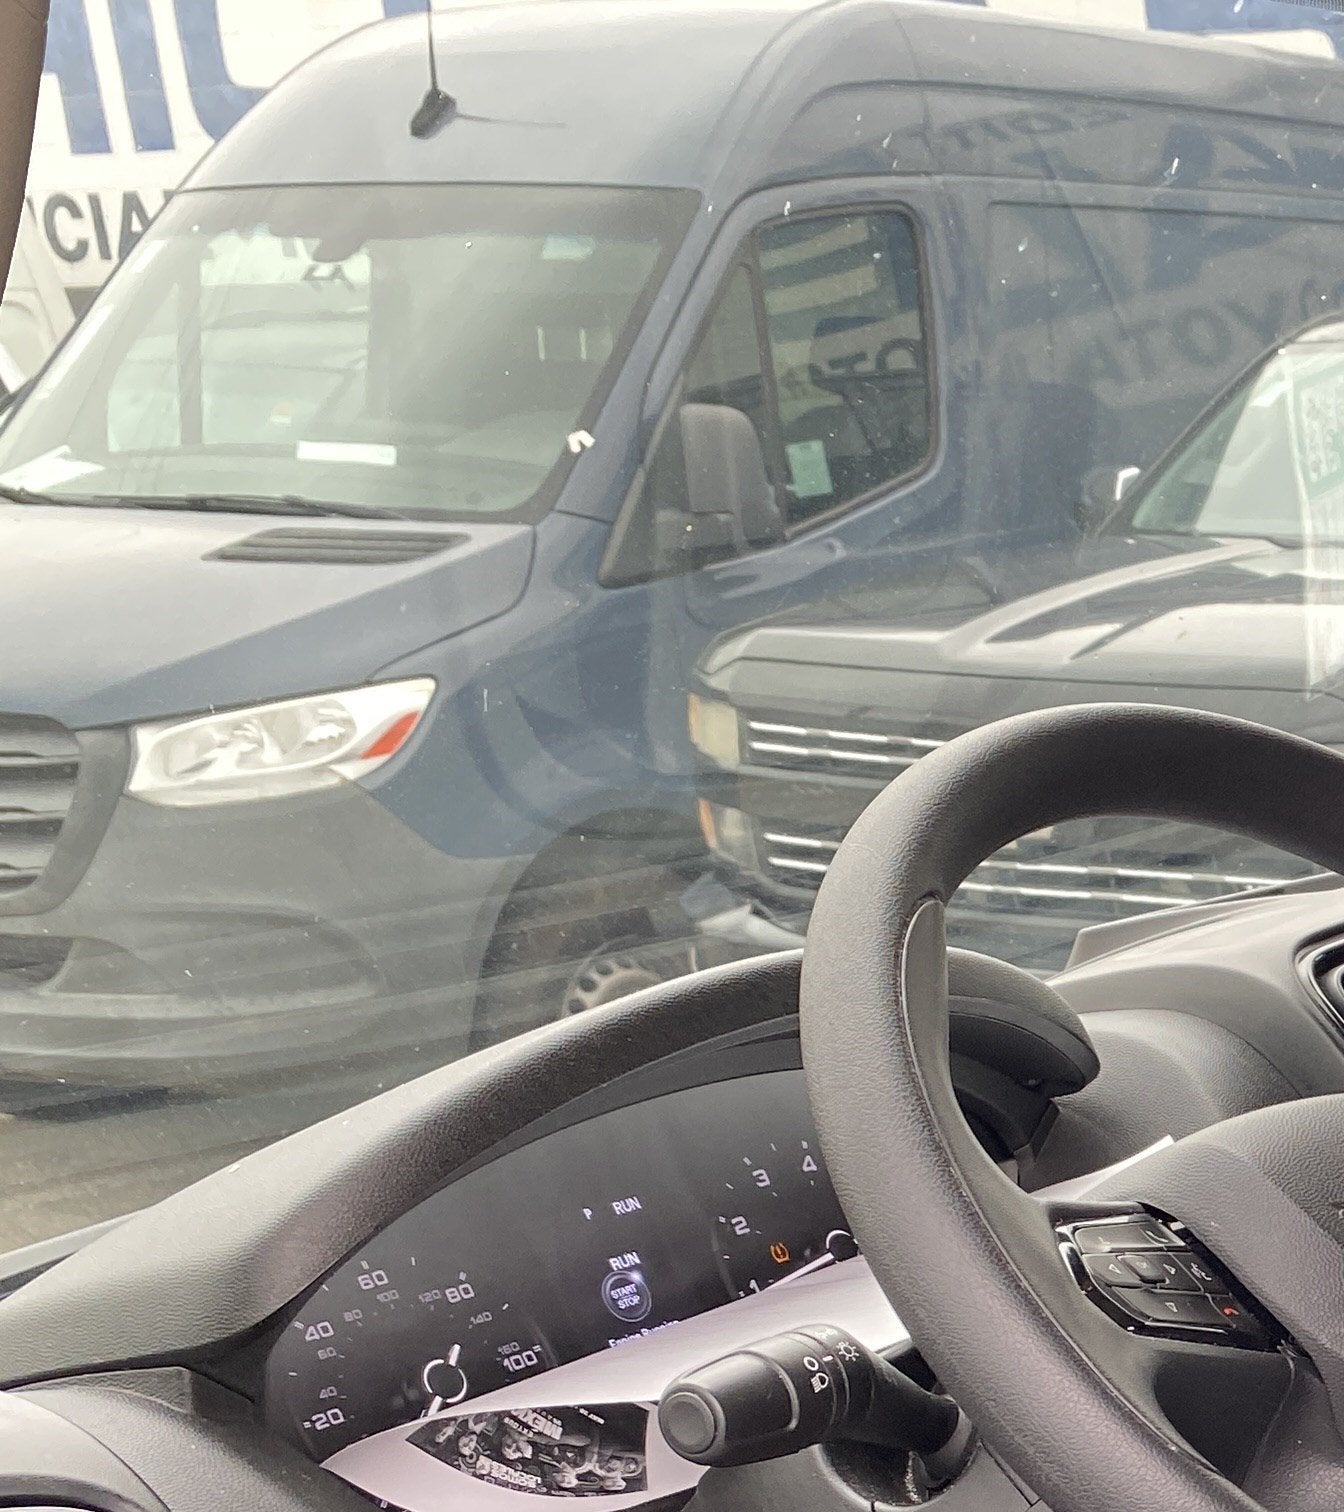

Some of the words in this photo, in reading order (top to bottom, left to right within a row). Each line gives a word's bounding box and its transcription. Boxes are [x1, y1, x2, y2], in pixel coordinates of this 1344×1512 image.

[26, 188, 175, 263] CIA
[802, 1155, 818, 1172] 4
[752, 1168, 771, 1188] 3
[583, 1207, 593, 1220] P
[611, 1196, 642, 1215] RUN
[731, 1215, 750, 1236] 2
[608, 1251, 642, 1272] RUN
[357, 1269, 389, 1291] 60
[376, 1290, 399, 1303] 100
[418, 1289, 441, 1304] 120
[445, 1283, 475, 1304] 80
[610, 1283, 638, 1300] START
[617, 1294, 641, 1310] STOP
[470, 1311, 493, 1325] 140
[304, 1321, 334, 1342] 40
[503, 1350, 539, 1372] 100
[319, 1386, 337, 1400] 40
[312, 1407, 345, 1431] 20
